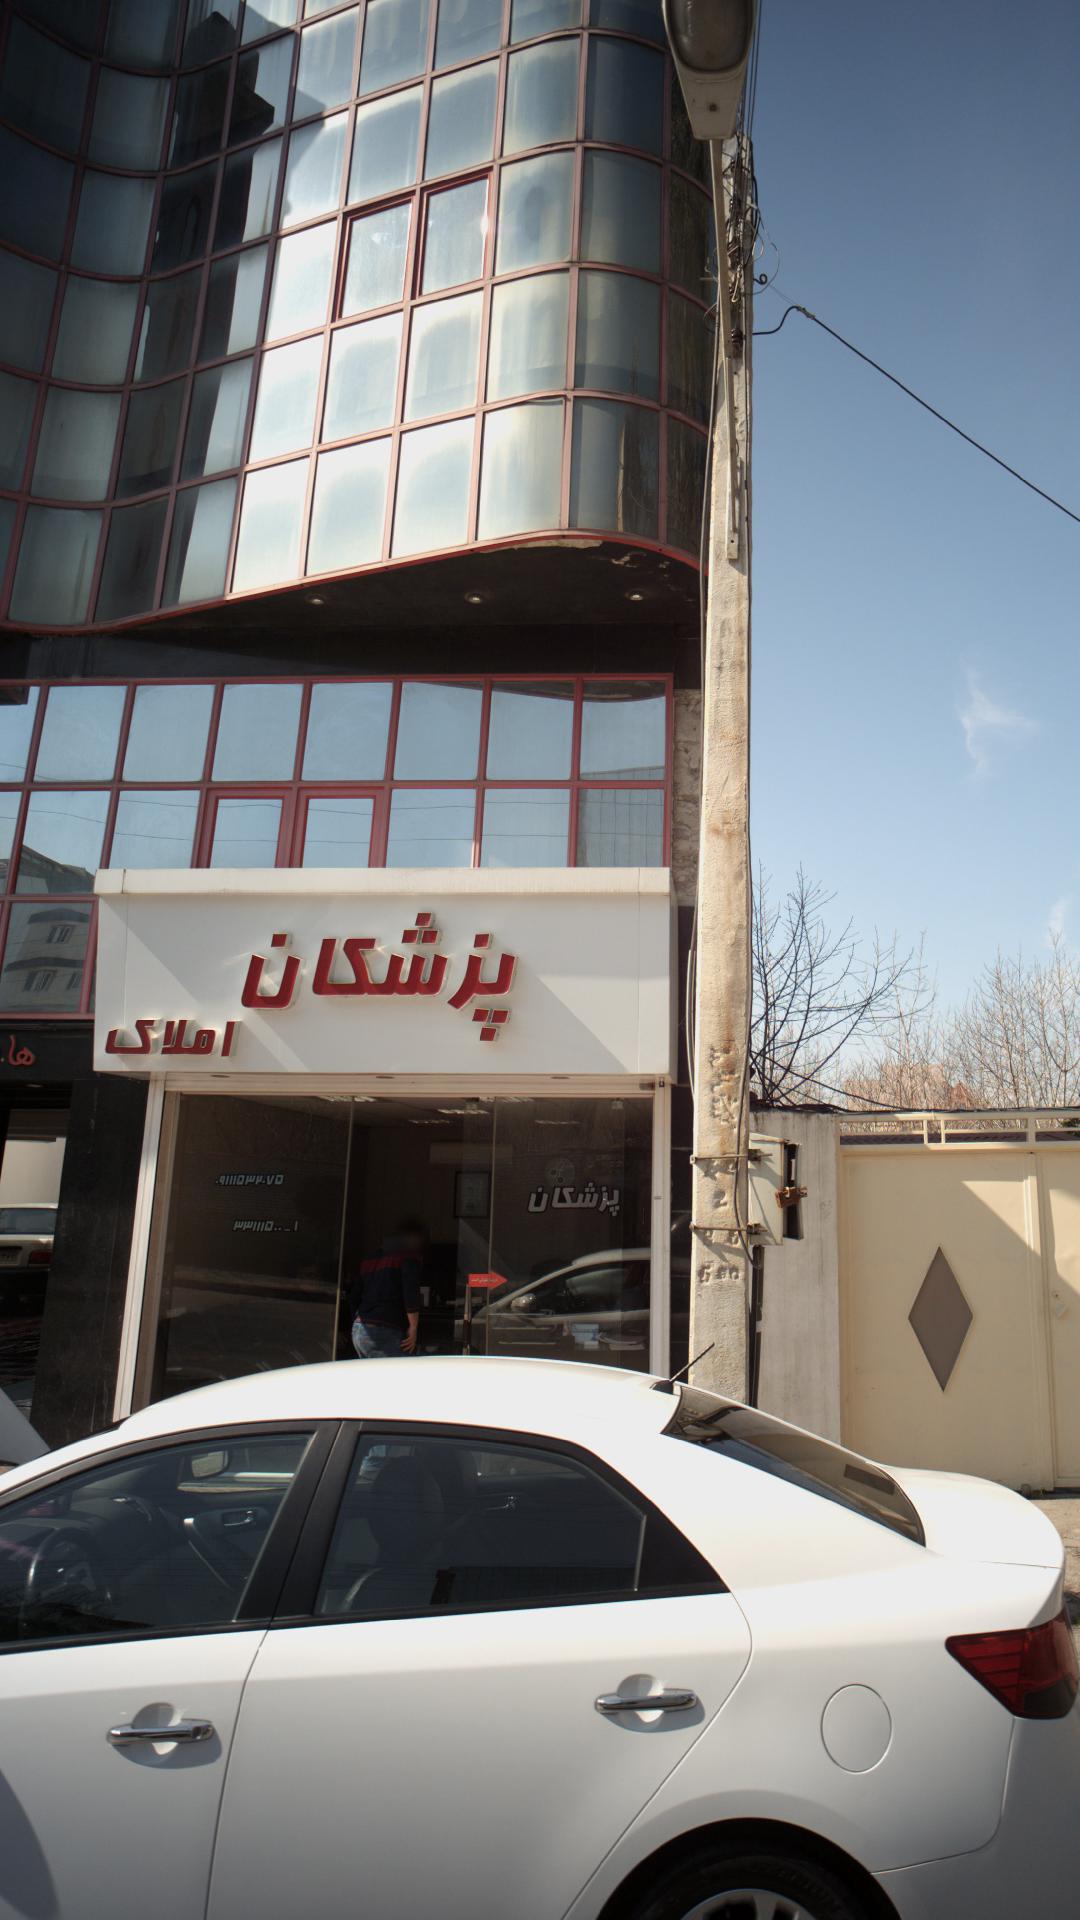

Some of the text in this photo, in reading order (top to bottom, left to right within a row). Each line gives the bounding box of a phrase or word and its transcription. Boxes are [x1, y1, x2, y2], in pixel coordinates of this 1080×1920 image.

[241, 912, 517, 1042] پزشکان
[105, 1019, 242, 1057] املاک
[528, 1182, 620, 1217] پزشکان
